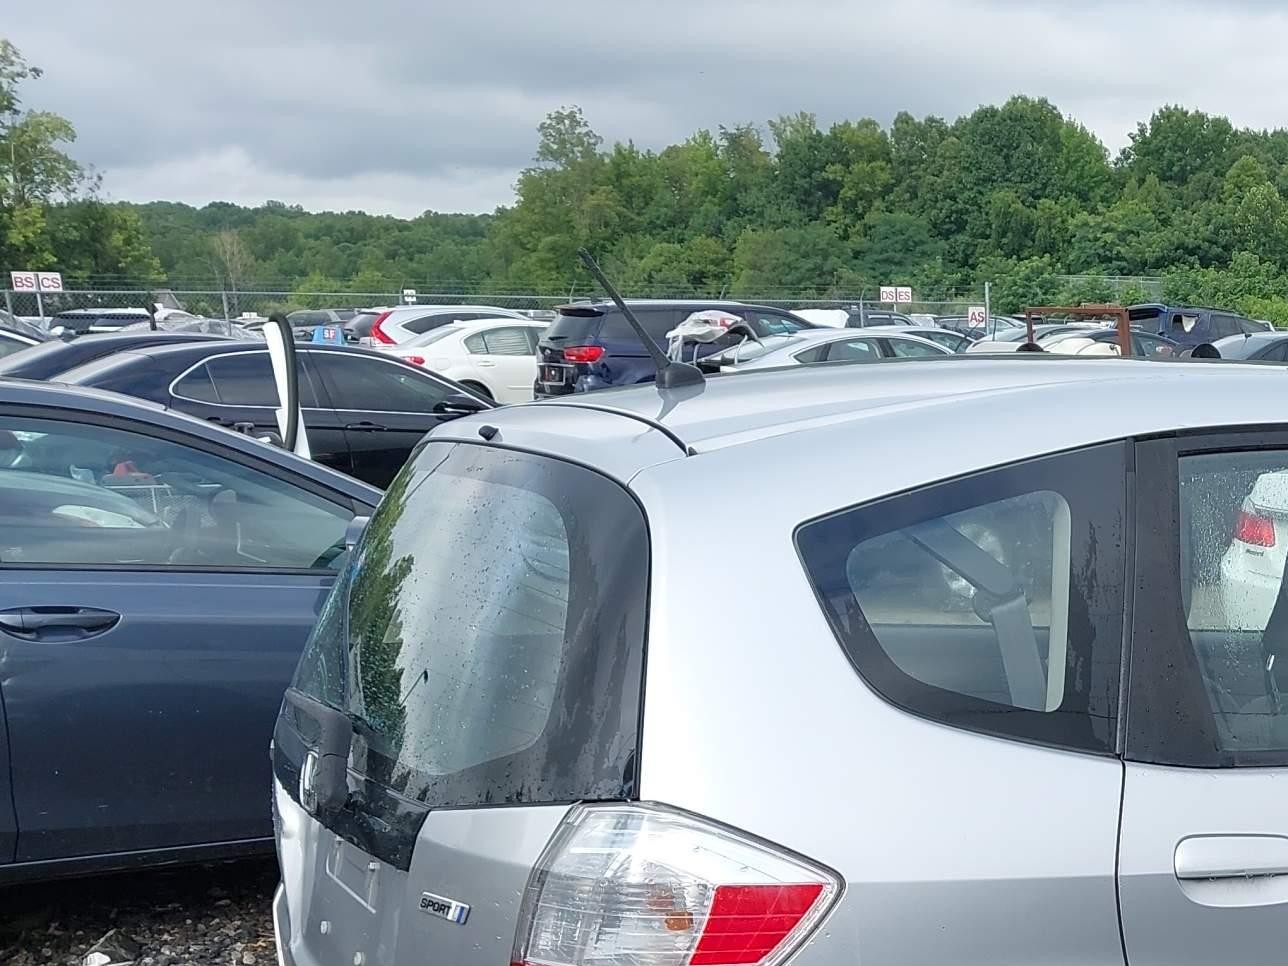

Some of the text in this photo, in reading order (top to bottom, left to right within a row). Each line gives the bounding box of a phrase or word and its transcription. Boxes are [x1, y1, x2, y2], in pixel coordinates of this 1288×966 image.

[14, 276, 34, 288] BS
[41, 277, 61, 289] CS
[881, 290, 894, 301] DS
[899, 290, 910, 301] ES
[970, 311, 985, 323] AS
[323, 329, 335, 338] SF
[420, 898, 451, 916] SPORT
